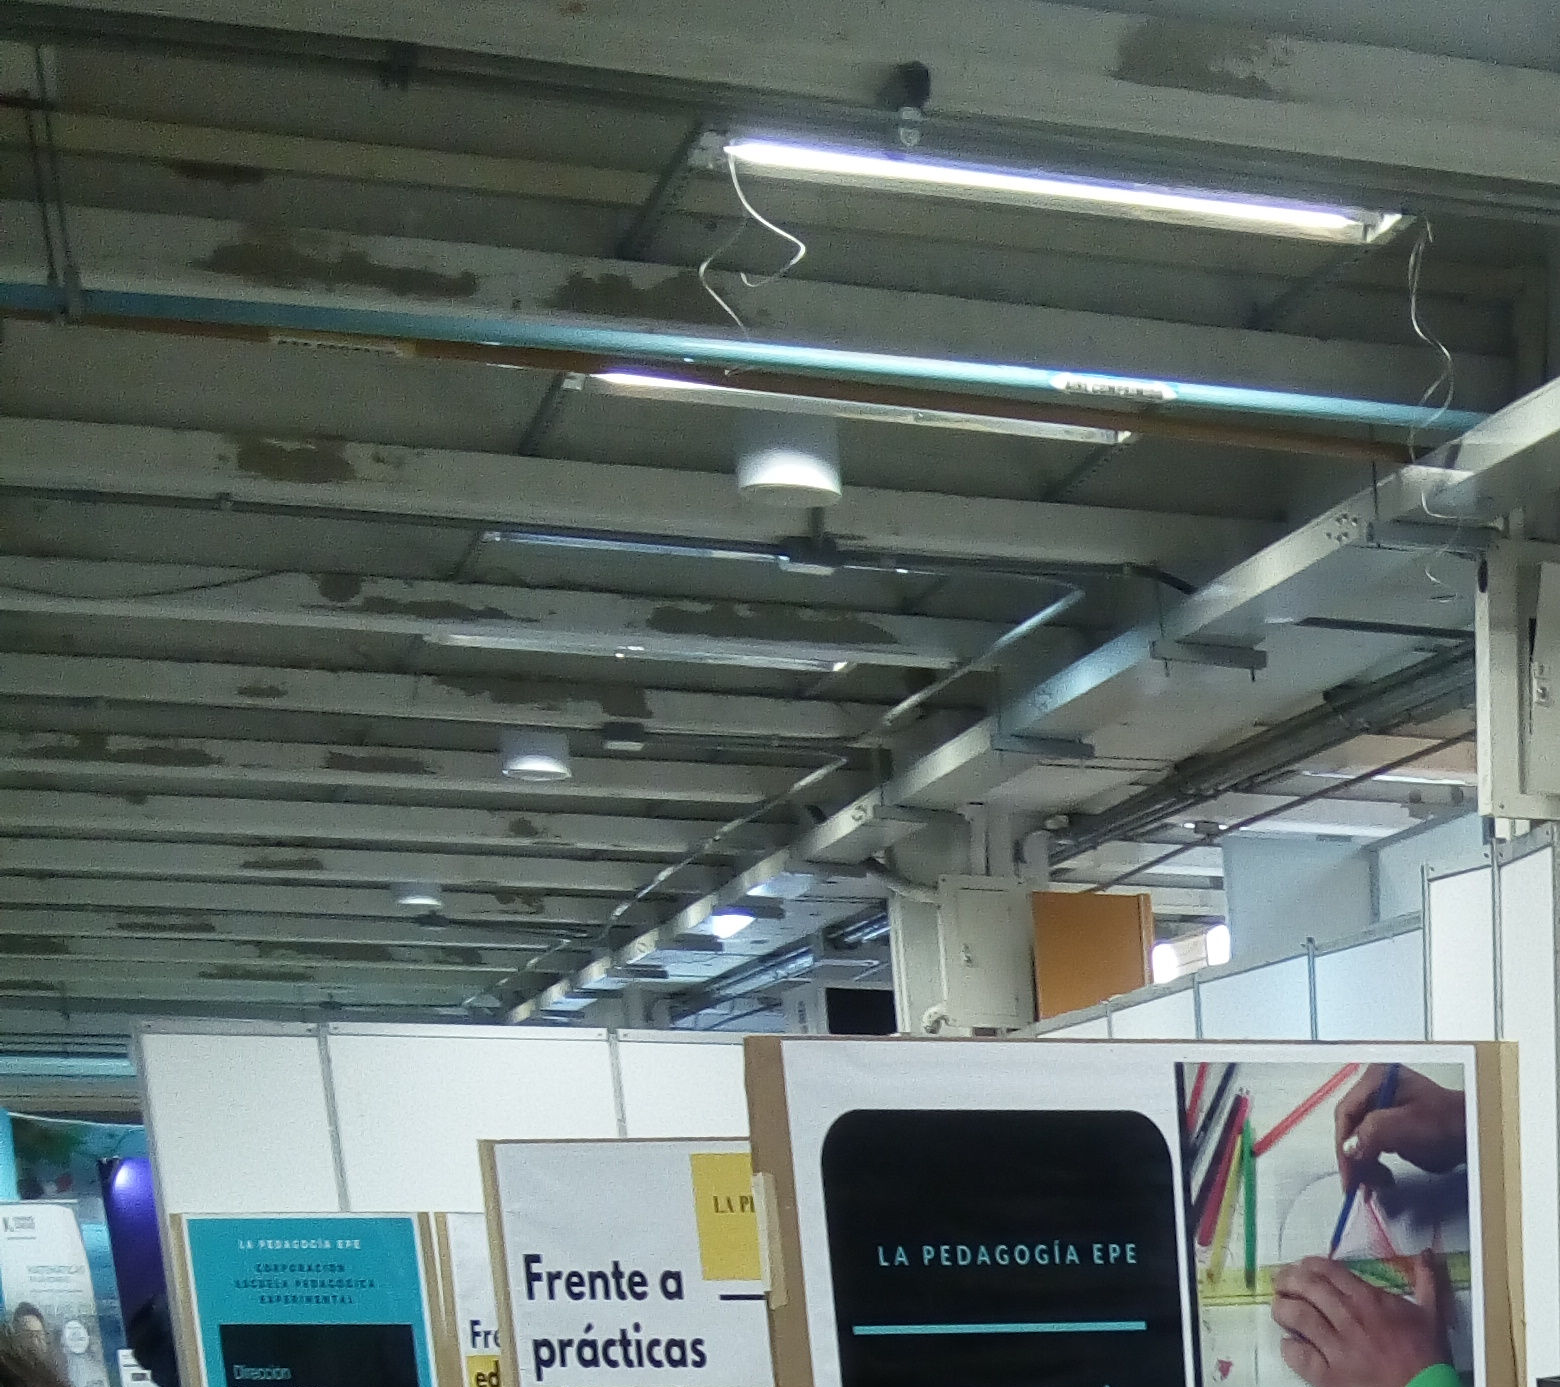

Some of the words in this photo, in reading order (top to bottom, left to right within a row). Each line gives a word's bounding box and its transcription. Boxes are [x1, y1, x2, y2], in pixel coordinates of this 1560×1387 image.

[523, 1253, 649, 1301] Frente
[660, 1269, 684, 1301] a
[878, 1243, 912, 1267] LA
[922, 1239, 1080, 1267] PEDAGOGÍA
[1093, 1242, 1139, 1265] EPE
[533, 1321, 708, 1382] prácticas
